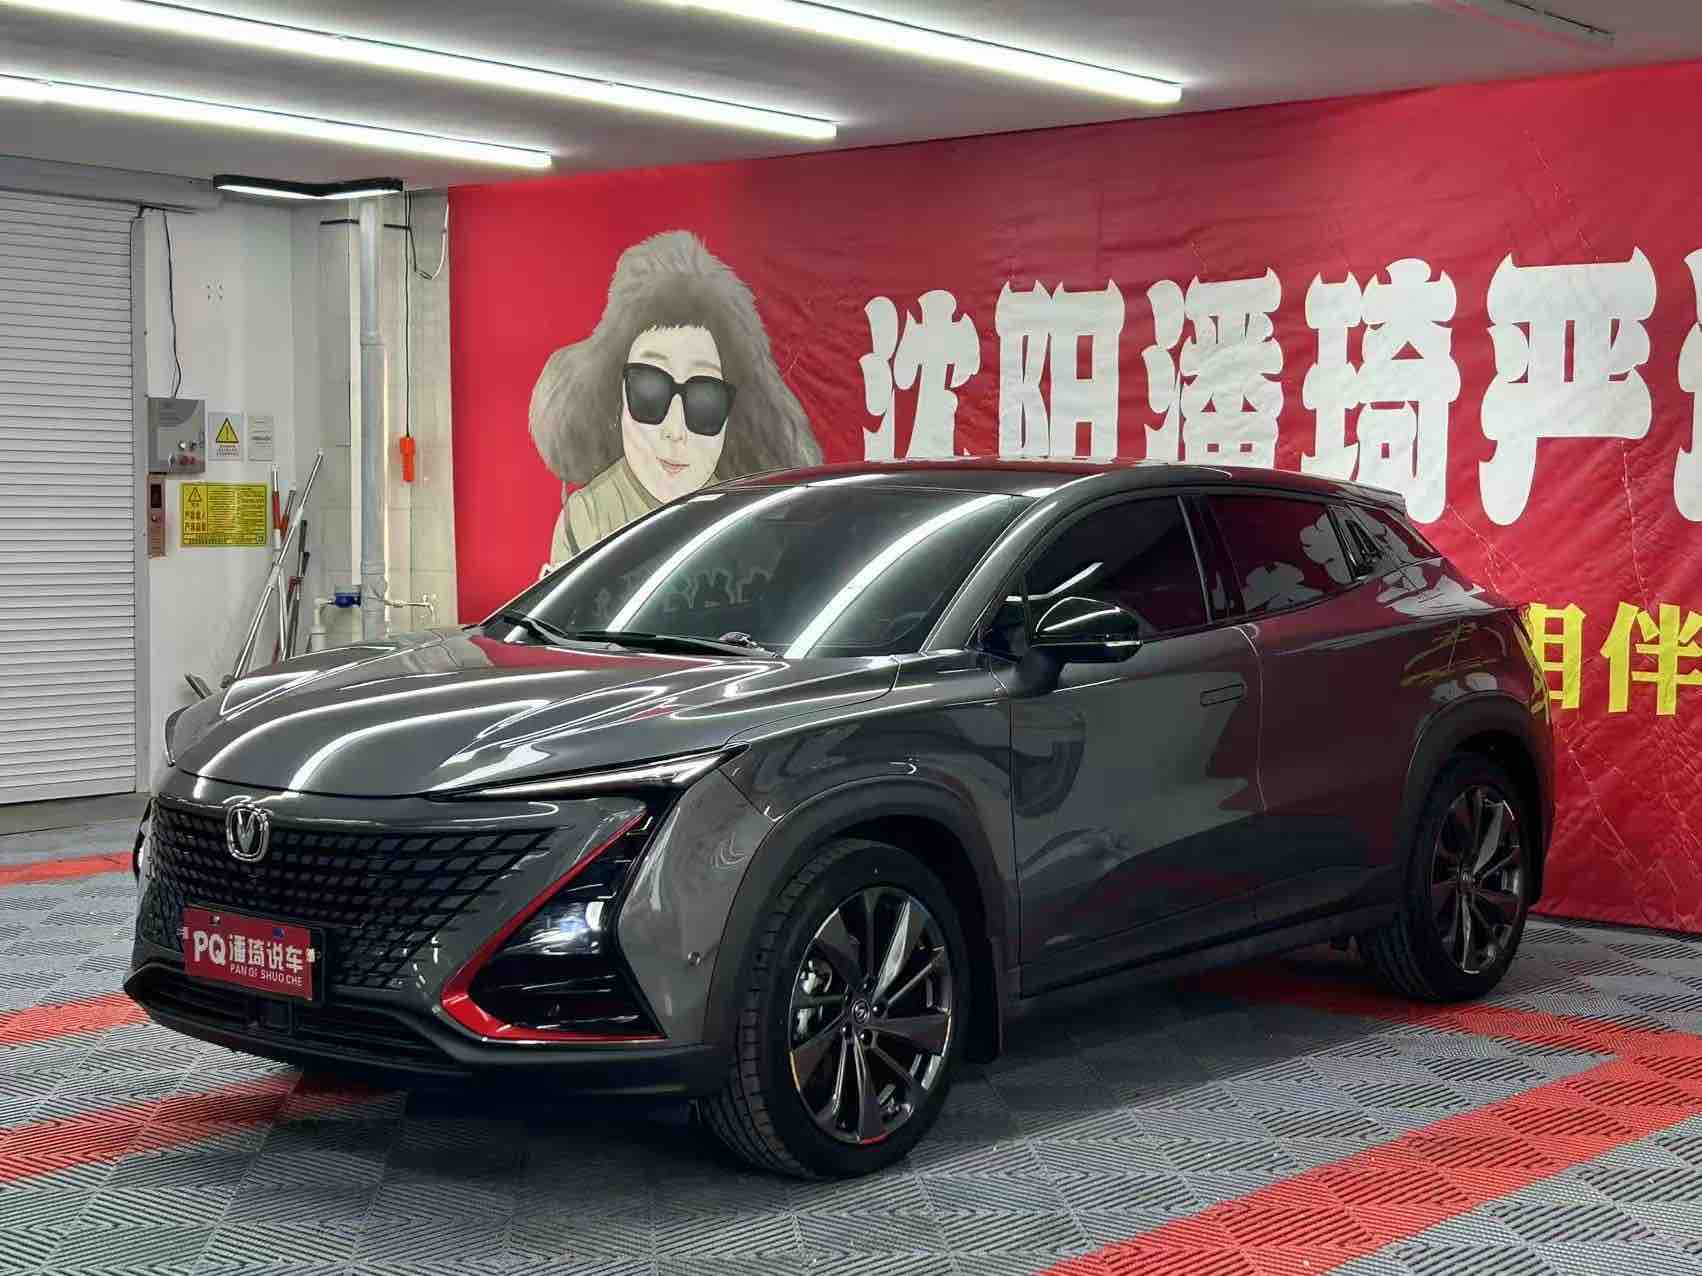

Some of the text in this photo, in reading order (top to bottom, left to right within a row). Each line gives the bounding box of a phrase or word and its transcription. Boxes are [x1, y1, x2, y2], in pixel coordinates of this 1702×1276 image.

[858, 246, 1702, 525] 沈阳潘琦严
[230, 963, 247, 977] PAN
[285, 974, 303, 985] CHE
